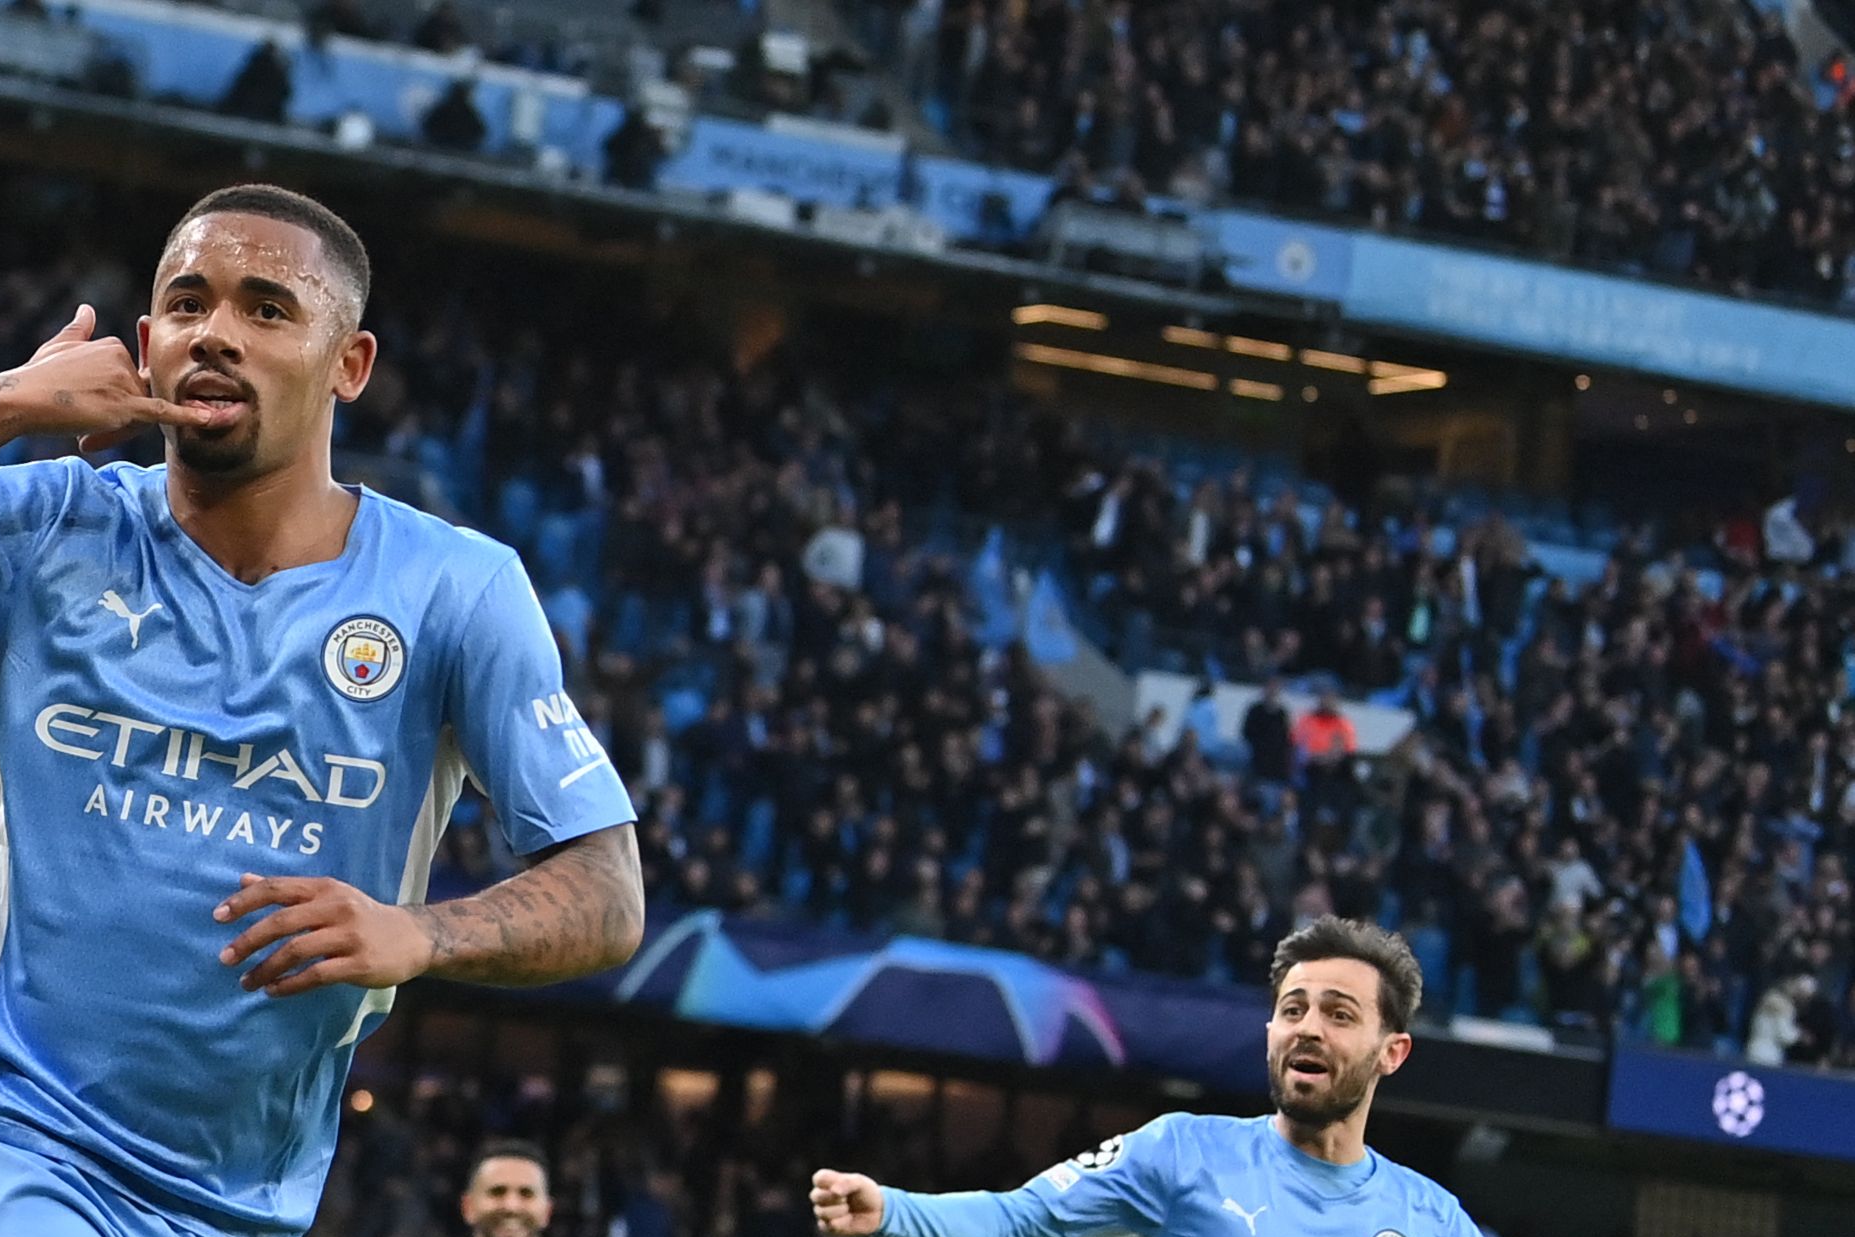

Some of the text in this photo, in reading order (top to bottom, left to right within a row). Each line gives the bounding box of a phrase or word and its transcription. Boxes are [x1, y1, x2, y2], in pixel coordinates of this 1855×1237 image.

[332, 620, 400, 653] MANCHESTER
[346, 685, 372, 697] CITY
[34, 703, 386, 809] ETIHAD
[84, 783, 324, 856] AIRWAYS
